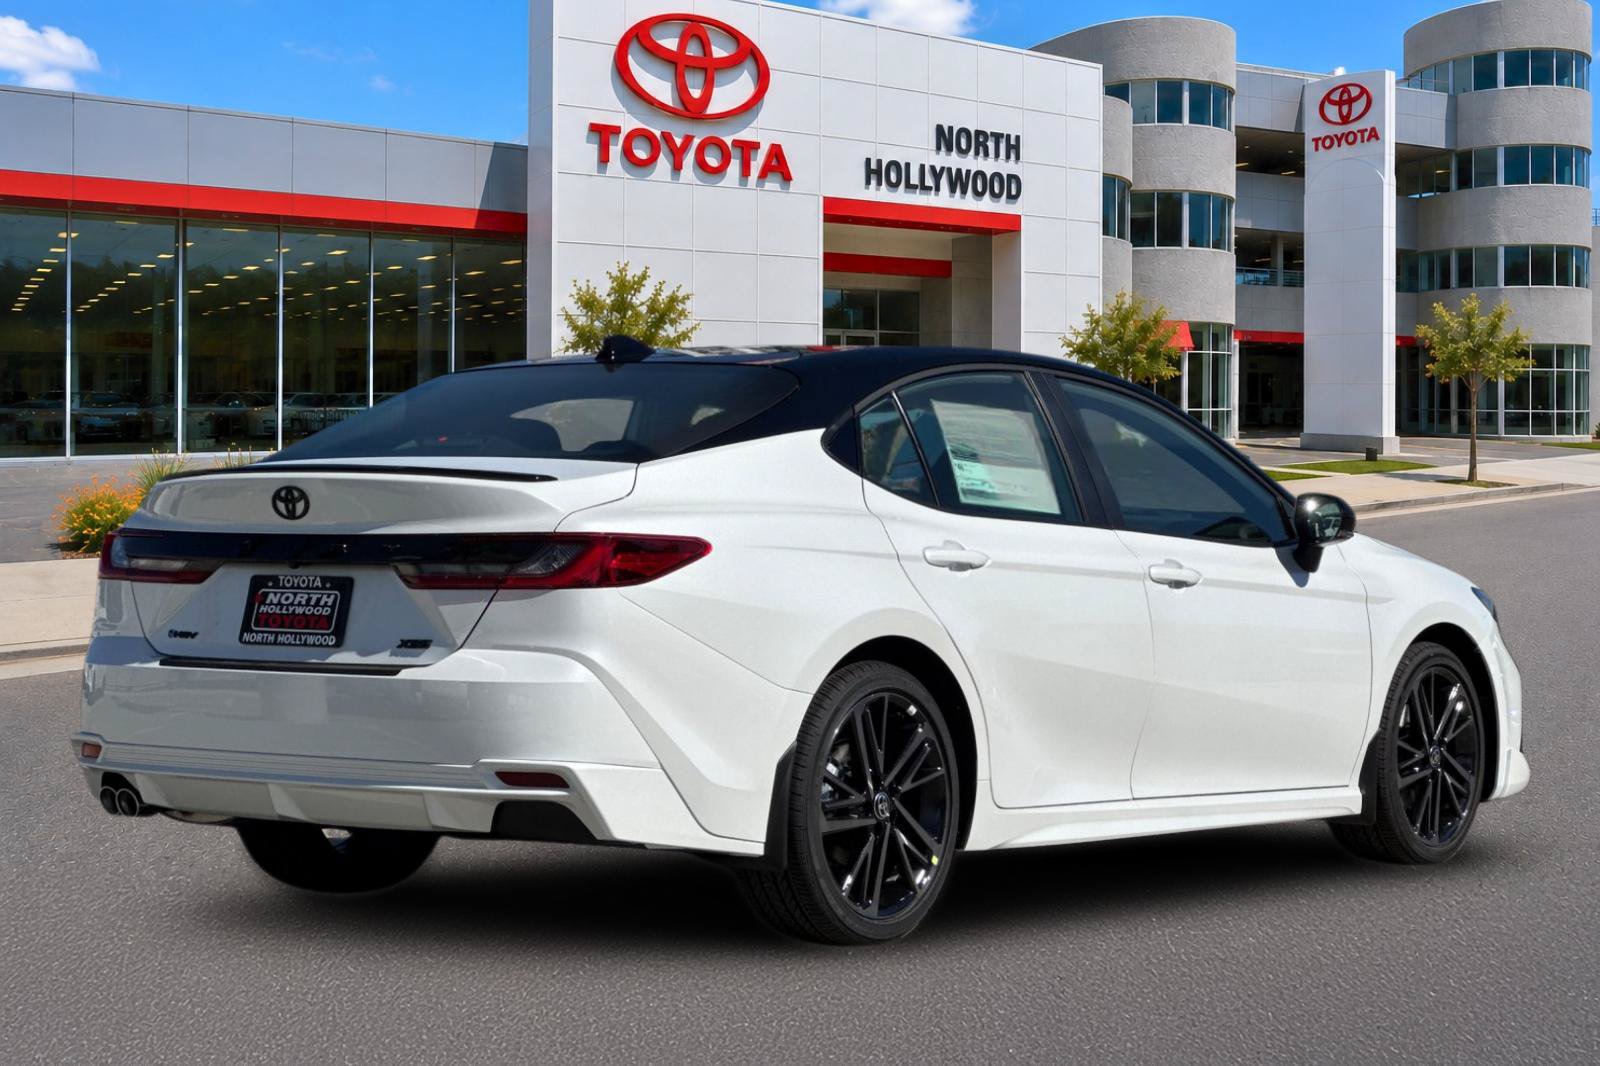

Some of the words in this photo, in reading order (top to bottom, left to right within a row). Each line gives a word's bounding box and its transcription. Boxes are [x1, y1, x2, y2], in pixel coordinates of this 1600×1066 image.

[935, 124, 1021, 162] NORTH
[1311, 126, 1380, 152] TOYOTA
[588, 122, 793, 182] TOYOTA
[865, 156, 1022, 201] HOLLYWOOD
[278, 575, 322, 588] TOYOTA
[265, 592, 336, 606] NORTH
[258, 605, 331, 616] HOLLYWOOD
[257, 614, 330, 629] TOYOTA
[242, 631, 275, 643] NORTH
[277, 633, 336, 646] HOLLYWOOD
